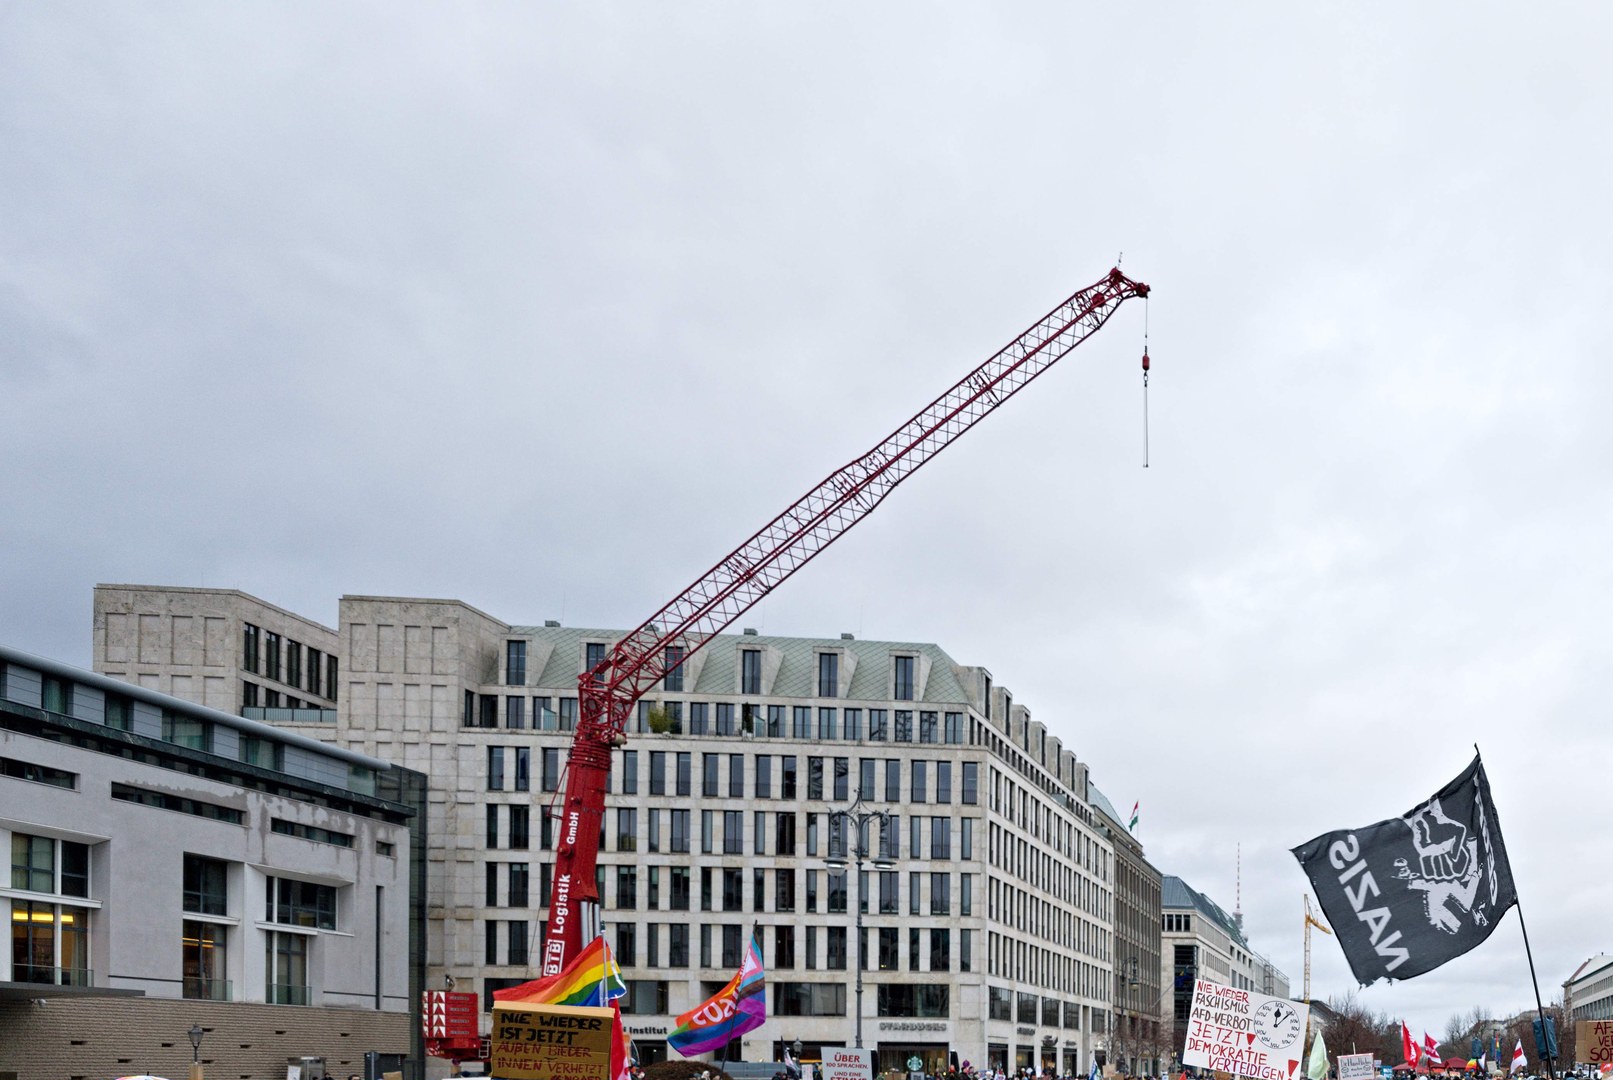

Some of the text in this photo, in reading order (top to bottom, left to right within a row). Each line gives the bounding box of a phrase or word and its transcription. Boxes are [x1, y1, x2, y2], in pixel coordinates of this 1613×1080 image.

[552, 874, 571, 934] Logistik
[566, 811, 579, 845] GmbH
[1197, 981, 1249, 1003] NIE WIEDER
[1196, 993, 1249, 1014] FASCHISMUS
[501, 1012, 532, 1024] NIE
[880, 1022, 947, 1031] STARBUCKS
[1192, 1007, 1253, 1031] AFD-VERBOT
[500, 1026, 579, 1045] IST JETZT
[834, 1052, 860, 1063] ÜBER
[1188, 1038, 1267, 1065] DEMOKRATIE
[548, 1062, 604, 1074] VERHETZT
